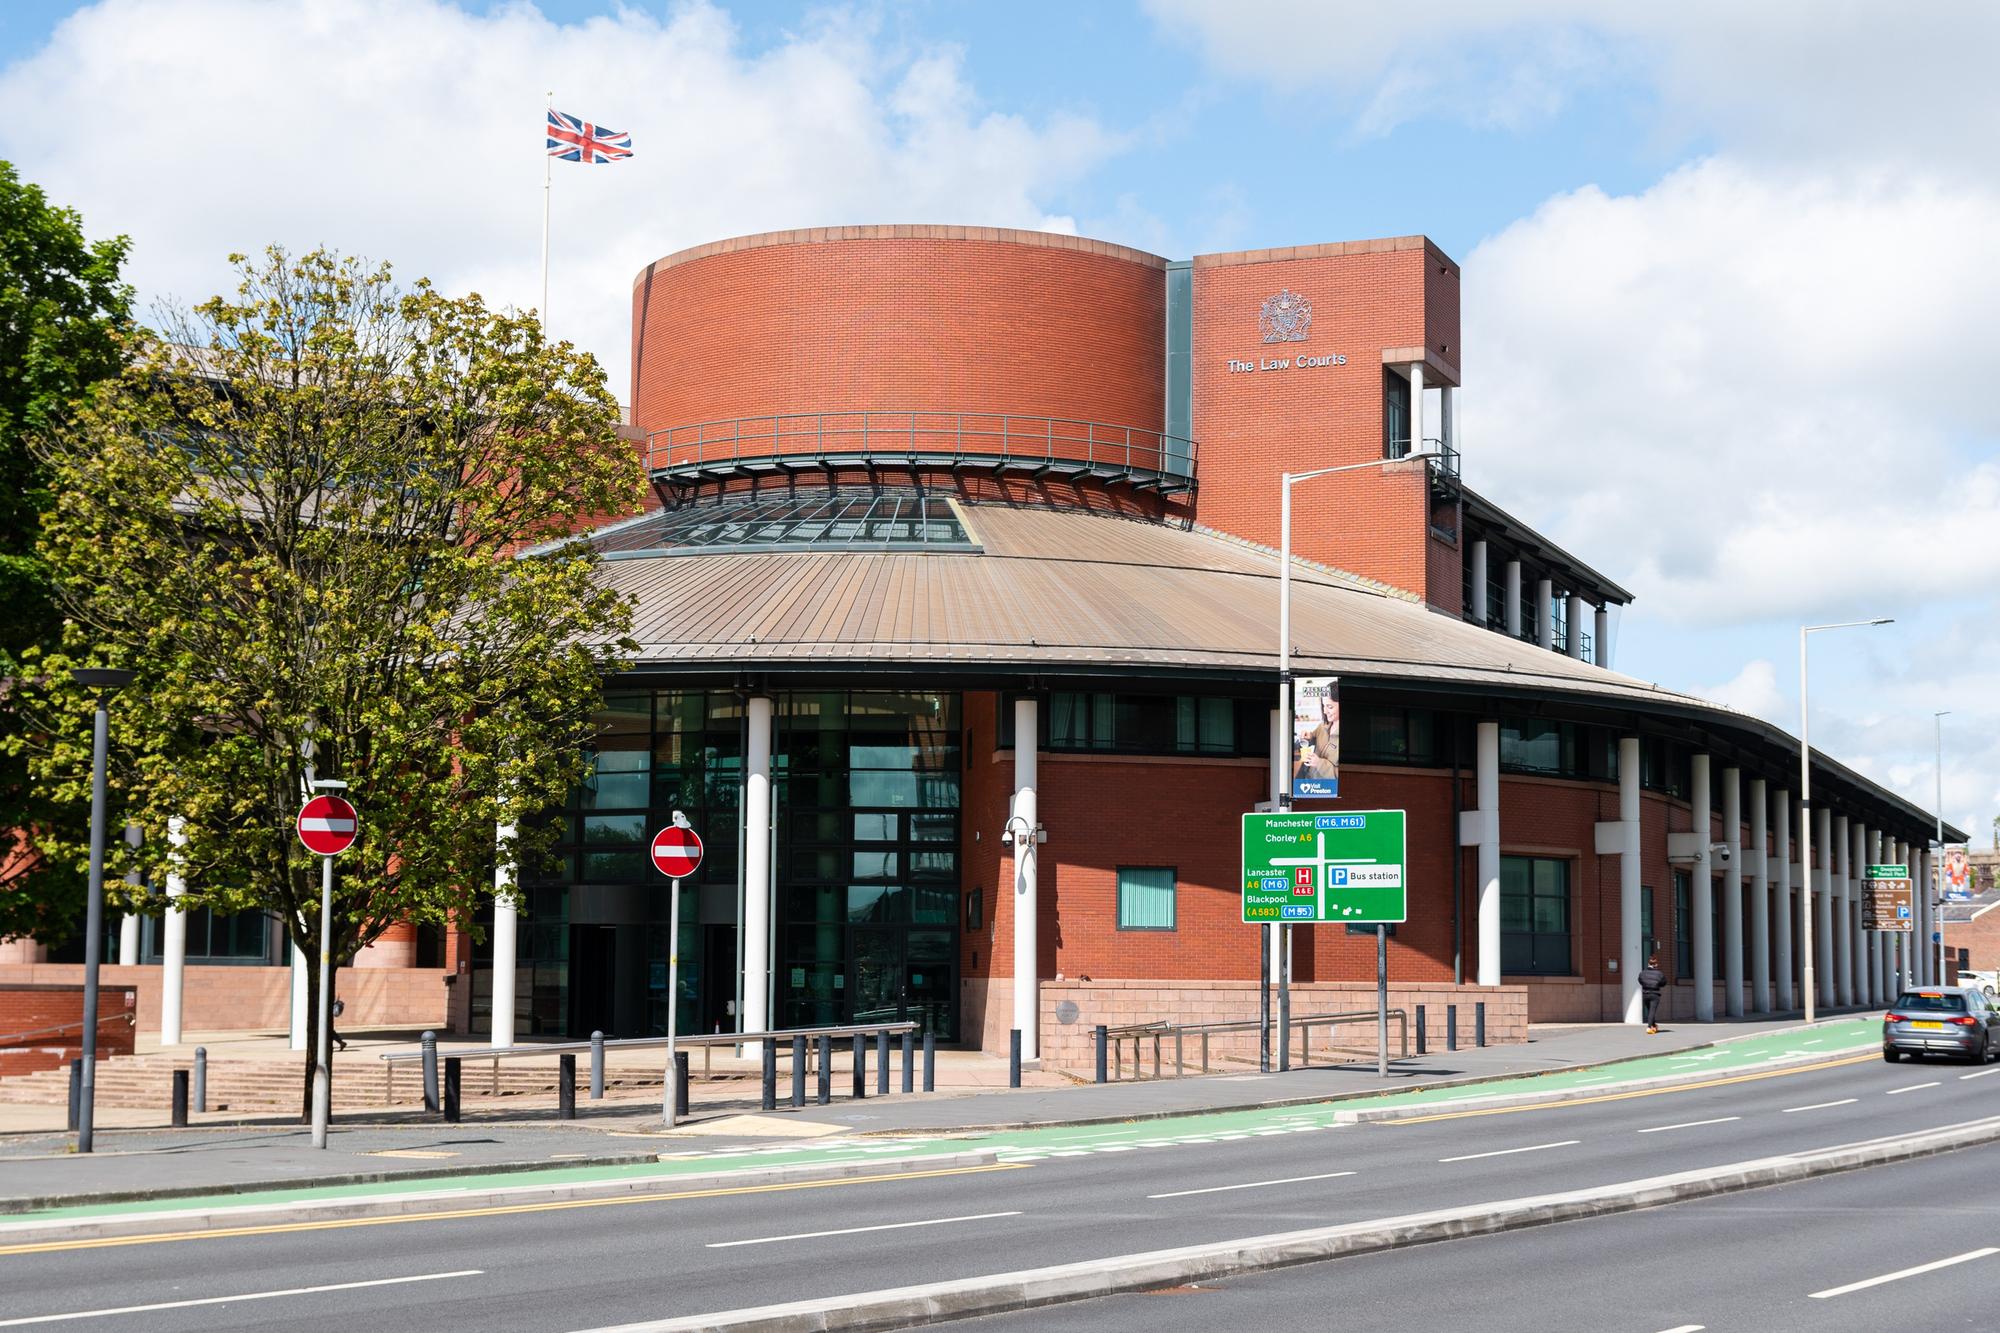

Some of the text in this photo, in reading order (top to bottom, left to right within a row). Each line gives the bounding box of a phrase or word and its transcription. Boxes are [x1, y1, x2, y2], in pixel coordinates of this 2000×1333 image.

[1228, 352, 1346, 373] The Law Courts
[1265, 819, 1313, 828] Manchester
[1265, 834, 1297, 843] Chorley
[1247, 868, 1286, 876] Lancaster
[1298, 869, 1309, 883] H
[1335, 870, 1399, 883] P Bus station
[1247, 895, 1288, 904] Blackpool
[1247, 907, 1279, 917] (A583)
[1900, 907, 1909, 917] P
